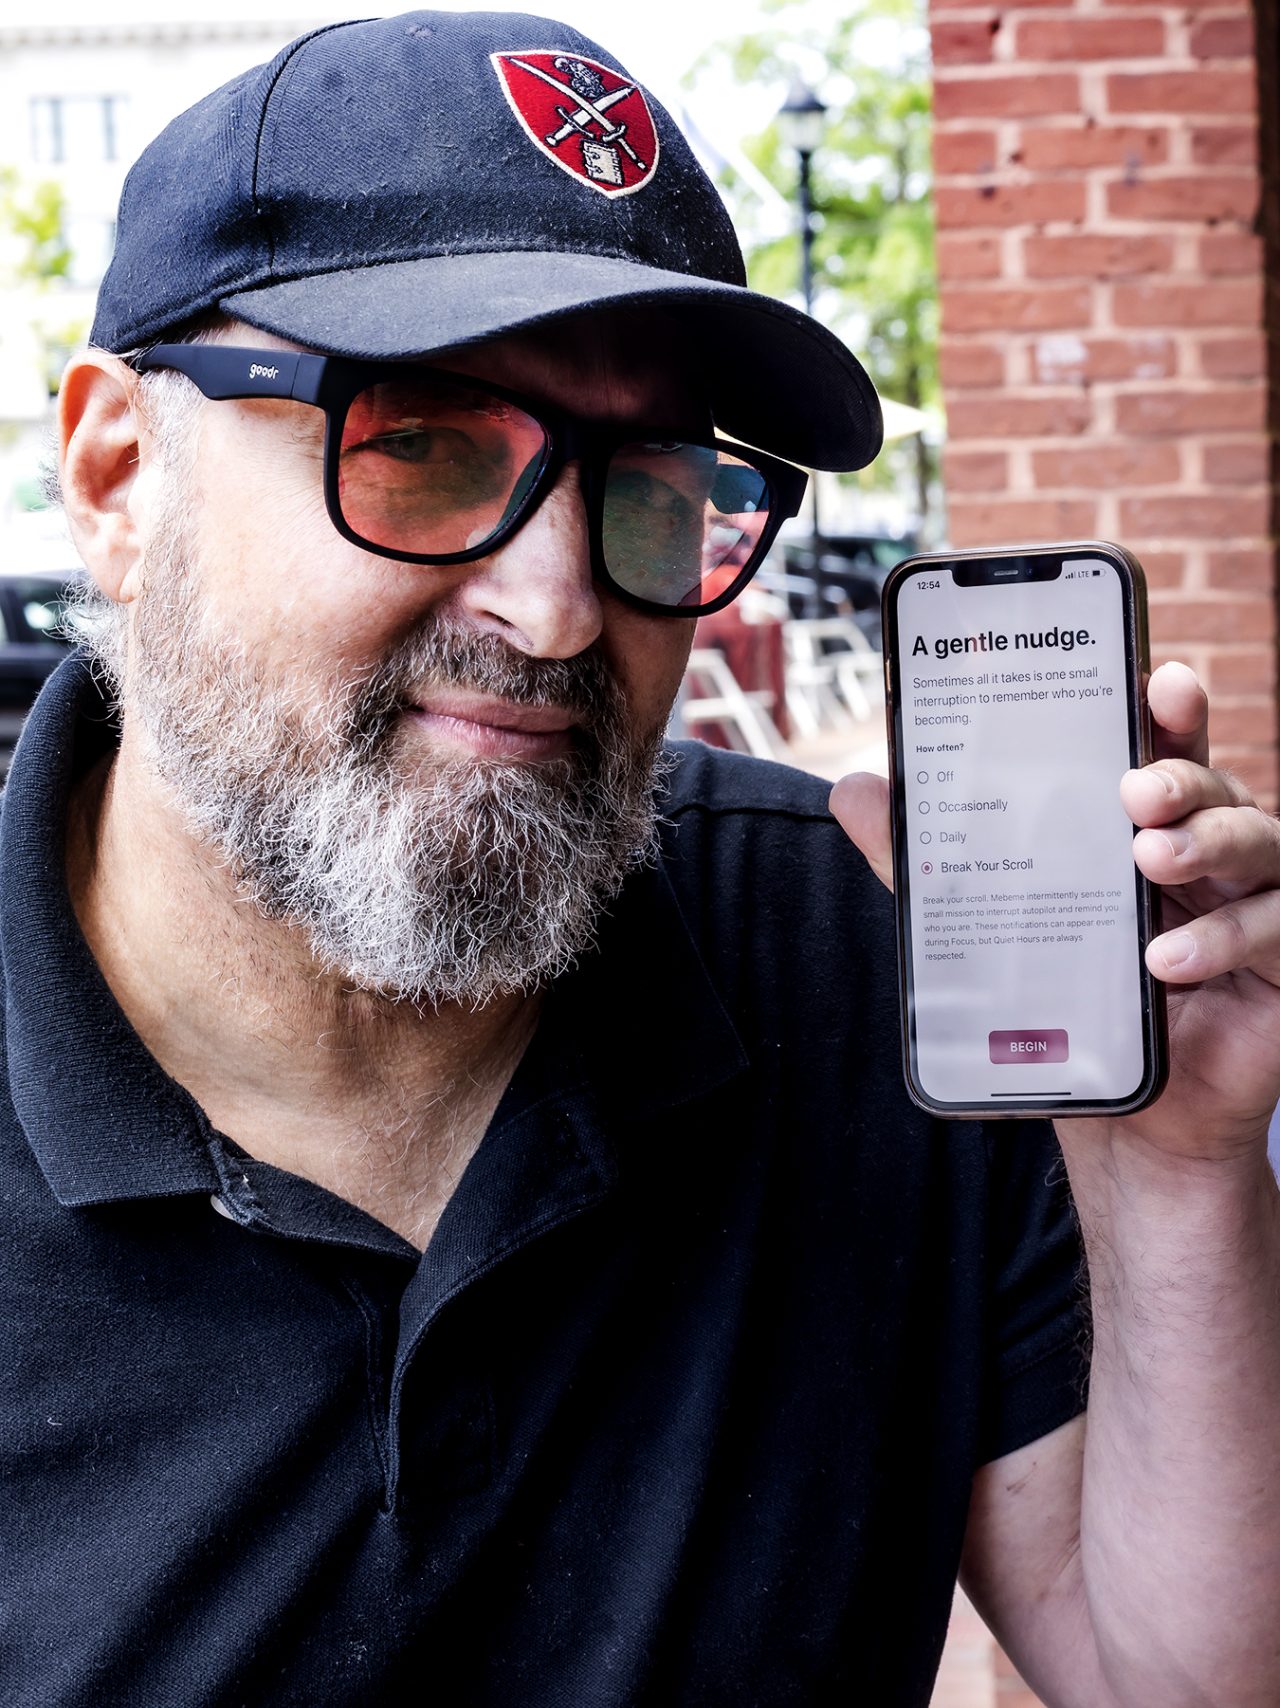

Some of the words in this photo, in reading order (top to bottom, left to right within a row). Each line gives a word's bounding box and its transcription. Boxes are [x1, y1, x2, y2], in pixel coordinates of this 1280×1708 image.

[249, 363, 279, 379] goodr
[917, 581, 941, 590] 12:54
[912, 635, 929, 656] A
[935, 631, 1008, 659] gentle
[1015, 627, 1096, 651] nudge.
[913, 676, 974, 689] Sometimes
[977, 673, 989, 685] all
[992, 673, 999, 684] it
[1001, 672, 1031, 683] takes
[1033, 670, 1043, 681] is
[1045, 670, 1066, 681] one
[1069, 666, 1098, 679] small
[914, 694, 977, 707] interruption
[979, 693, 990, 703] to
[992, 690, 1049, 703] remember
[1052, 688, 1076, 699] who
[1078, 685, 1113, 700] you're
[914, 713, 972, 726] becoming.
[916, 744, 935, 753] How
[936, 743, 965, 751] often?
[937, 771, 954, 782] Off
[938, 798, 1008, 812] Occasionally
[940, 831, 967, 844] Daily
[941, 861, 972, 873] Break
[974, 860, 1000, 872] Your
[1002, 858, 1033, 871] Scroll
[922, 896, 944, 904] Break
[946, 896, 964, 905] your
[965, 894, 989, 902] scroll.
[1026, 891, 1079, 900] intermittently
[1080, 890, 1105, 898] sends
[923, 910, 943, 918] small
[945, 909, 975, 917] mission
[986, 907, 1020, 917] interrupt
[1022, 906, 1056, 915] autopilot
[1058, 905, 1073, 913] and
[1075, 904, 1102, 912] remind
[1104, 904, 1119, 912] you
[924, 924, 940, 932] who
[942, 924, 957, 933] you
[975, 922, 999, 930] These
[1000, 920, 1049, 929] notifications
[1066, 920, 1095, 928] appear
[924, 937, 950, 947] during
[951, 937, 976, 945] Focus,
[993, 935, 1014, 944] Quiet
[1017, 935, 1040, 943] Hours
[1056, 934, 1083, 943] always
[925, 951, 967, 961] respected.
[1010, 1041, 1047, 1052] BEGIN
